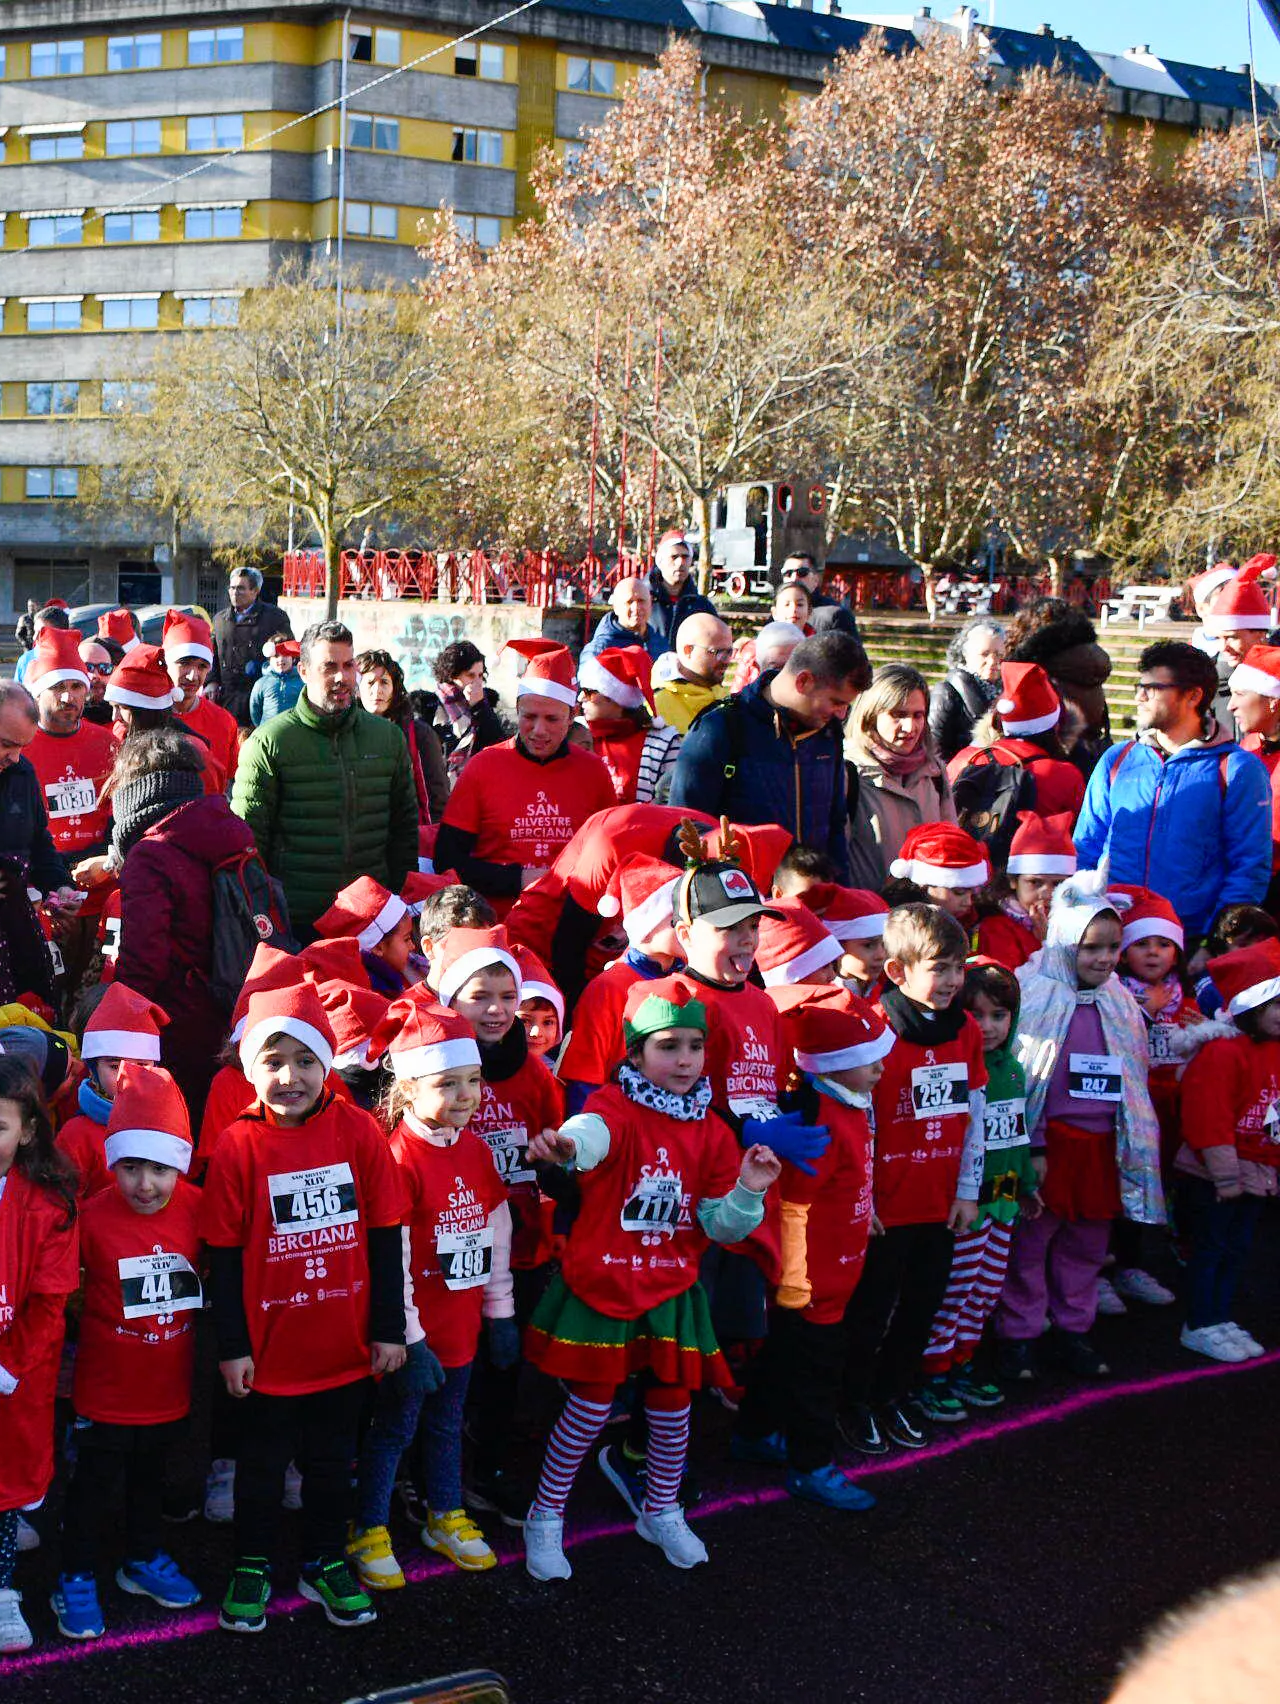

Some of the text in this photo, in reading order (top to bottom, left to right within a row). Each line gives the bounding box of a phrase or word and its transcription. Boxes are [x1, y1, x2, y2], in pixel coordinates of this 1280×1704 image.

[54, 790, 93, 811] 1030
[526, 803, 560, 817] SAN
[514, 816, 572, 828] SILVESTRE
[510, 827, 575, 839] BERCIANA
[743, 1042, 769, 1062] SAN
[920, 1081, 953, 1107] 252
[1082, 1077, 1108, 1092] 1247
[986, 1115, 1018, 1140] 282
[493, 1146, 522, 1175] 02
[304, 1176, 326, 1187] XLIV
[291, 1186, 341, 1221] 456
[448, 1189, 475, 1209] SAN
[637, 1194, 675, 1222] 717
[438, 1203, 484, 1223] SILVESTRE
[268, 1223, 356, 1254] BERCIANA
[151, 1261, 172, 1270] XLIV
[449, 1249, 484, 1279] 498
[141, 1273, 173, 1303] 44
